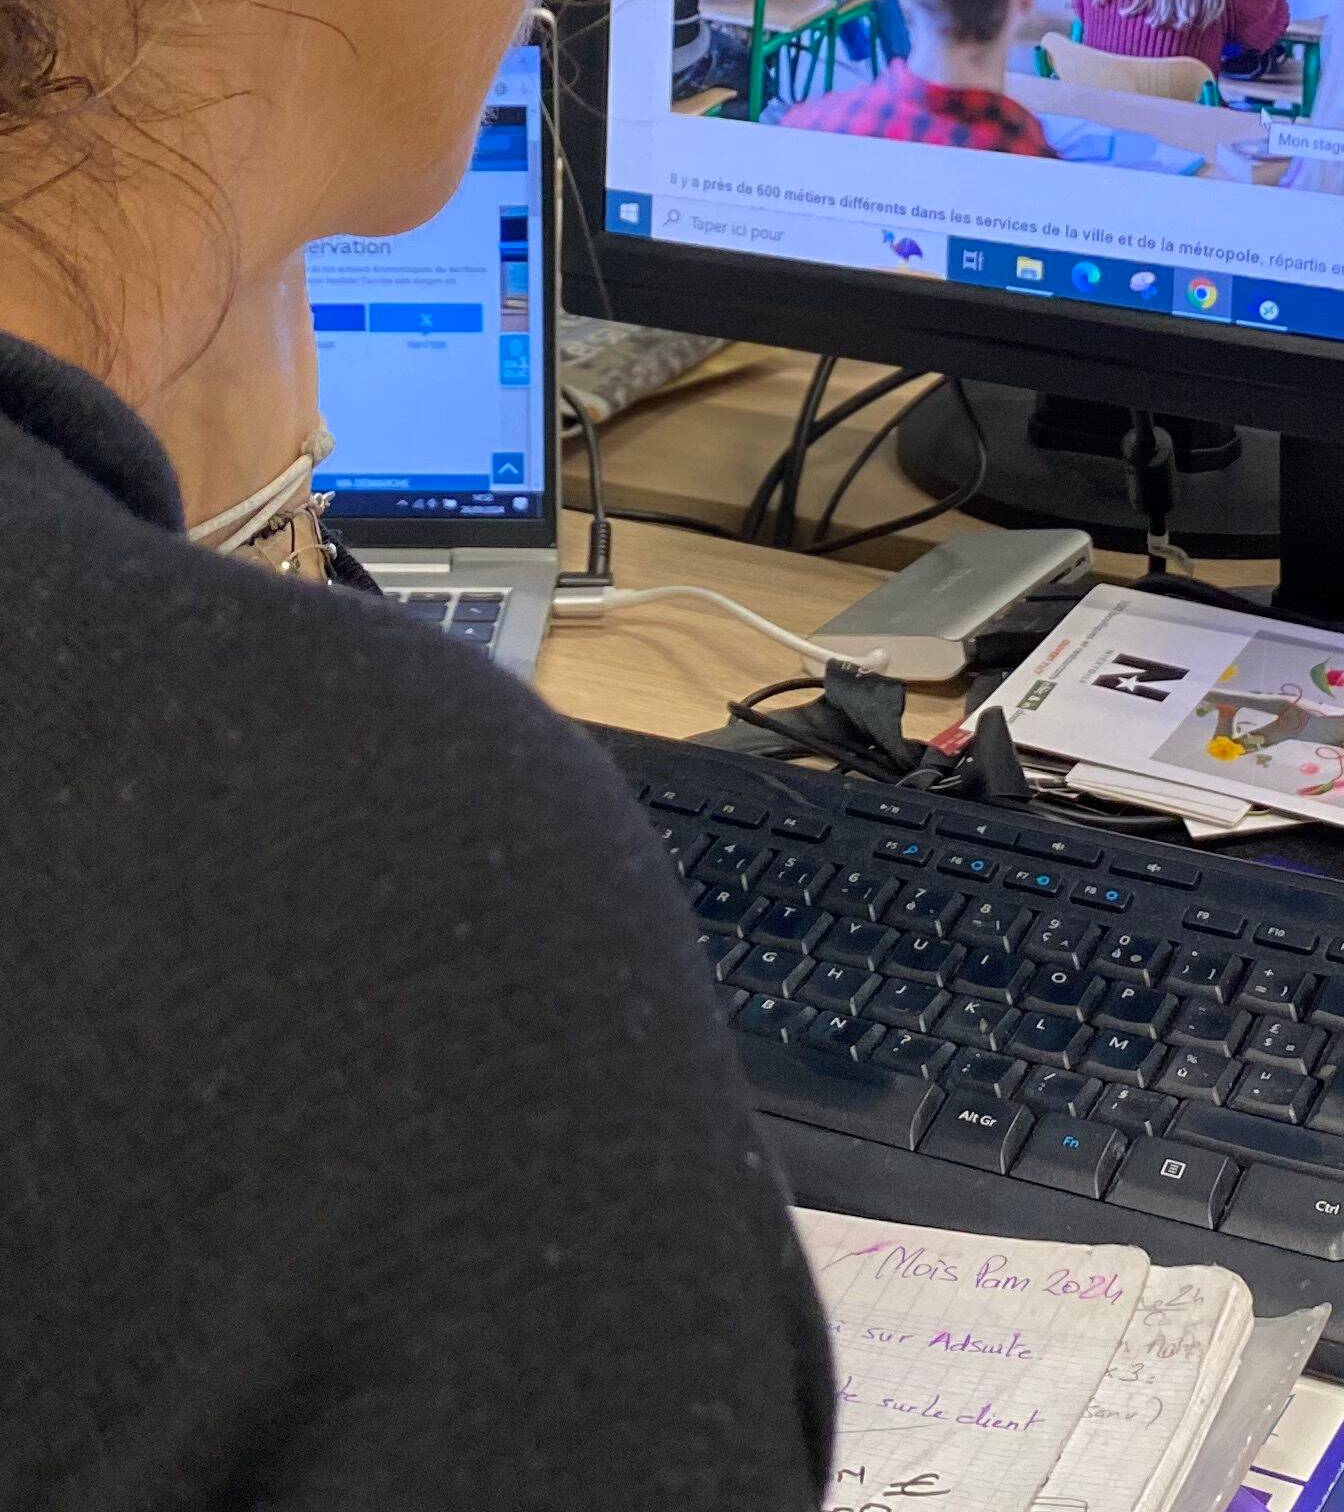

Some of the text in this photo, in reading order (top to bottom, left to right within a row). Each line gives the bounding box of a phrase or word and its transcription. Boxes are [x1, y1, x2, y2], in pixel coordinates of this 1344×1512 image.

[1278, 132, 1309, 149] Mon
[691, 215, 784, 244] Taper ici pour
[702, 178, 733, 195] près
[736, 181, 753, 196] de
[756, 183, 781, 200] 600
[784, 186, 836, 206] métiers
[839, 192, 907, 217] différents
[911, 202, 946, 221] dans
[950, 208, 972, 225] les
[975, 213, 1038, 234] services
[1042, 220, 1061, 236] de
[1064, 224, 1079, 239] la
[1082, 226, 1114, 244] ville
[1118, 232, 1133, 248] et
[1136, 233, 1156, 249] de
[1160, 236, 1174, 252] la
[1269, 253, 1327, 275] répartis
[1268, 927, 1286, 937] F10
[913, 938, 929, 950] U
[762, 951, 777, 963] G
[827, 967, 843, 980] H
[761, 999, 775, 1011] B
[830, 1017, 847, 1030] N
[1108, 1036, 1128, 1051] M
[958, 1110, 997, 1128] Alt Gr
[1062, 1136, 1080, 1150] Fn
[1315, 1200, 1340, 1216] Ctrl
